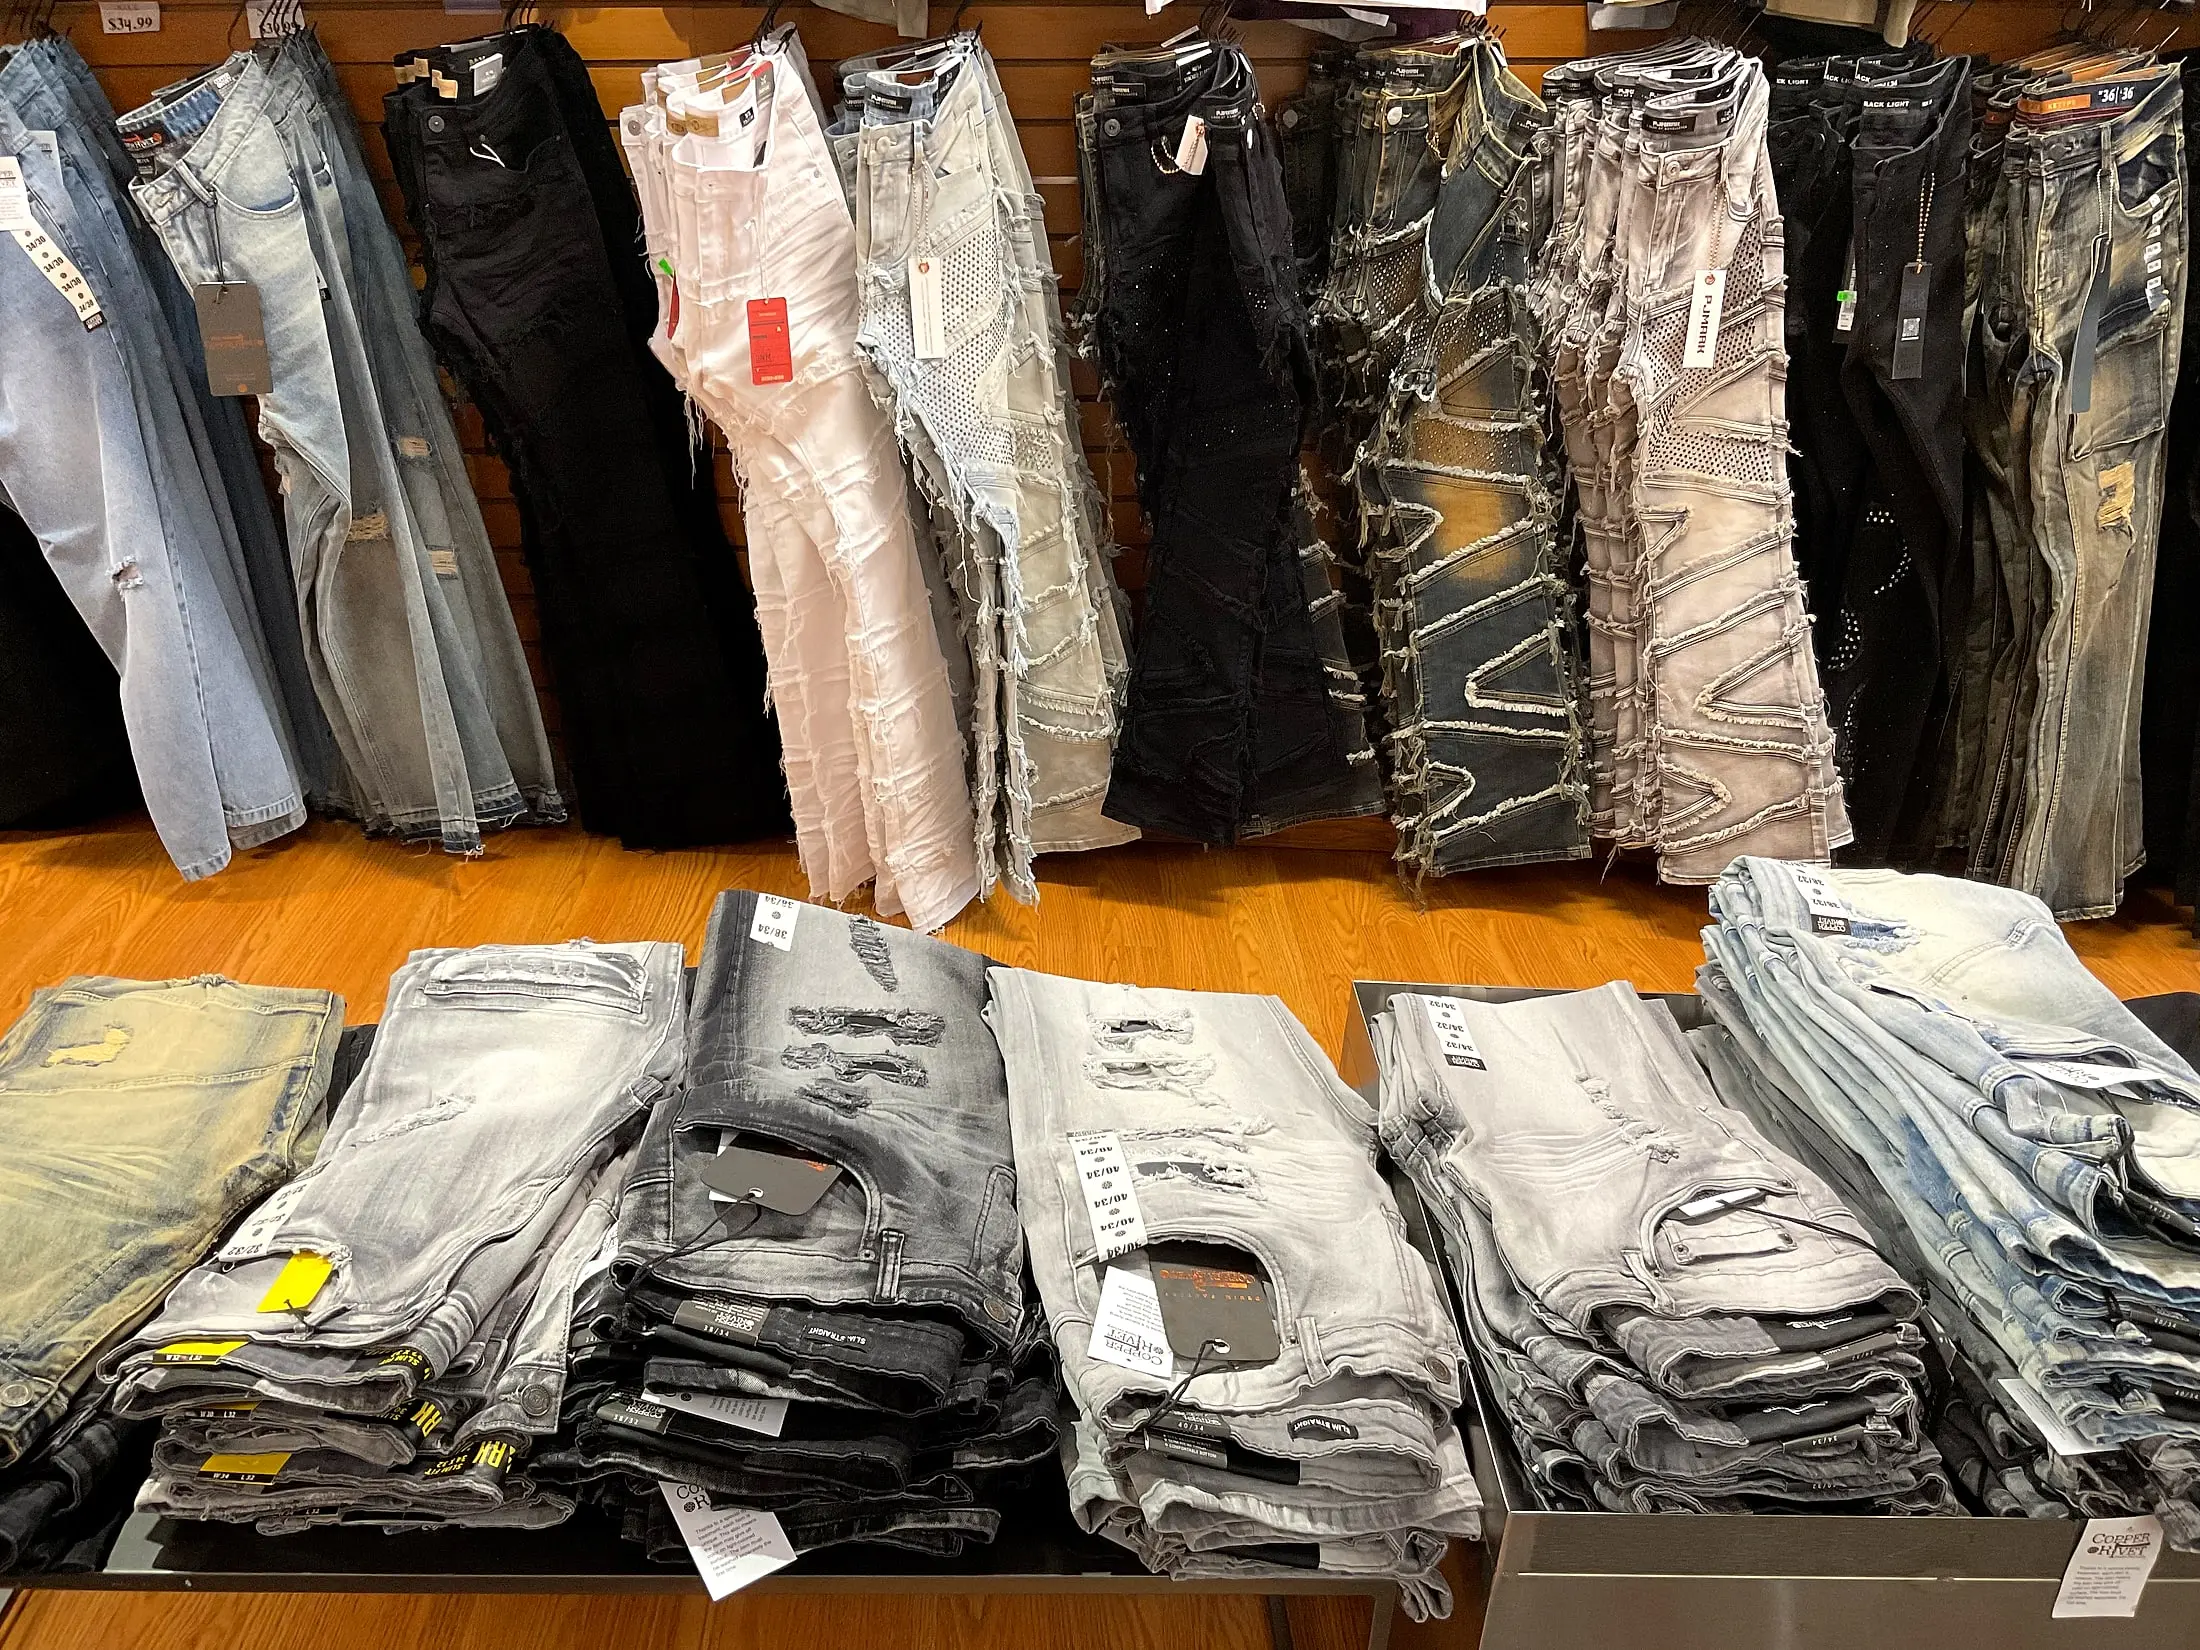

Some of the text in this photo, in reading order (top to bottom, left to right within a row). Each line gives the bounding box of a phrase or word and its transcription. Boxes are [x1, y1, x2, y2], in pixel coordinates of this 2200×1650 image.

[108, 17, 153, 32] $34.99
[25, 235, 47, 252] 34/30
[43, 257, 65, 273] 34/30
[61, 276, 82, 292] 34/30
[79, 298, 94, 313] 34/30
[758, 923, 788, 940] 38/34
[1428, 1000, 1457, 1011] 34/32
[1436, 1021, 1465, 1033] 34/32
[1445, 1040, 1474, 1052] 34/32
[1080, 1146, 1113, 1156] 40/34
[1086, 1165, 1120, 1180] 40/34
[1094, 1192, 1128, 1208] 40/34
[1100, 1217, 1135, 1231] 40/34
[227, 1243, 263, 1256] 32/32
[714, 1316, 753, 1332] COPPER
[808, 1327, 846, 1343] STRAIGHT
[1106, 1328, 1153, 1352] RIVET
[1105, 1338, 1163, 1366] COPPER
[1293, 1418, 1351, 1436] SLIM STRAIGHT
[441, 1462, 464, 1472] SLIM
[2092, 1532, 2151, 1544] COPPER
[2098, 1543, 2148, 1559] RIVET
